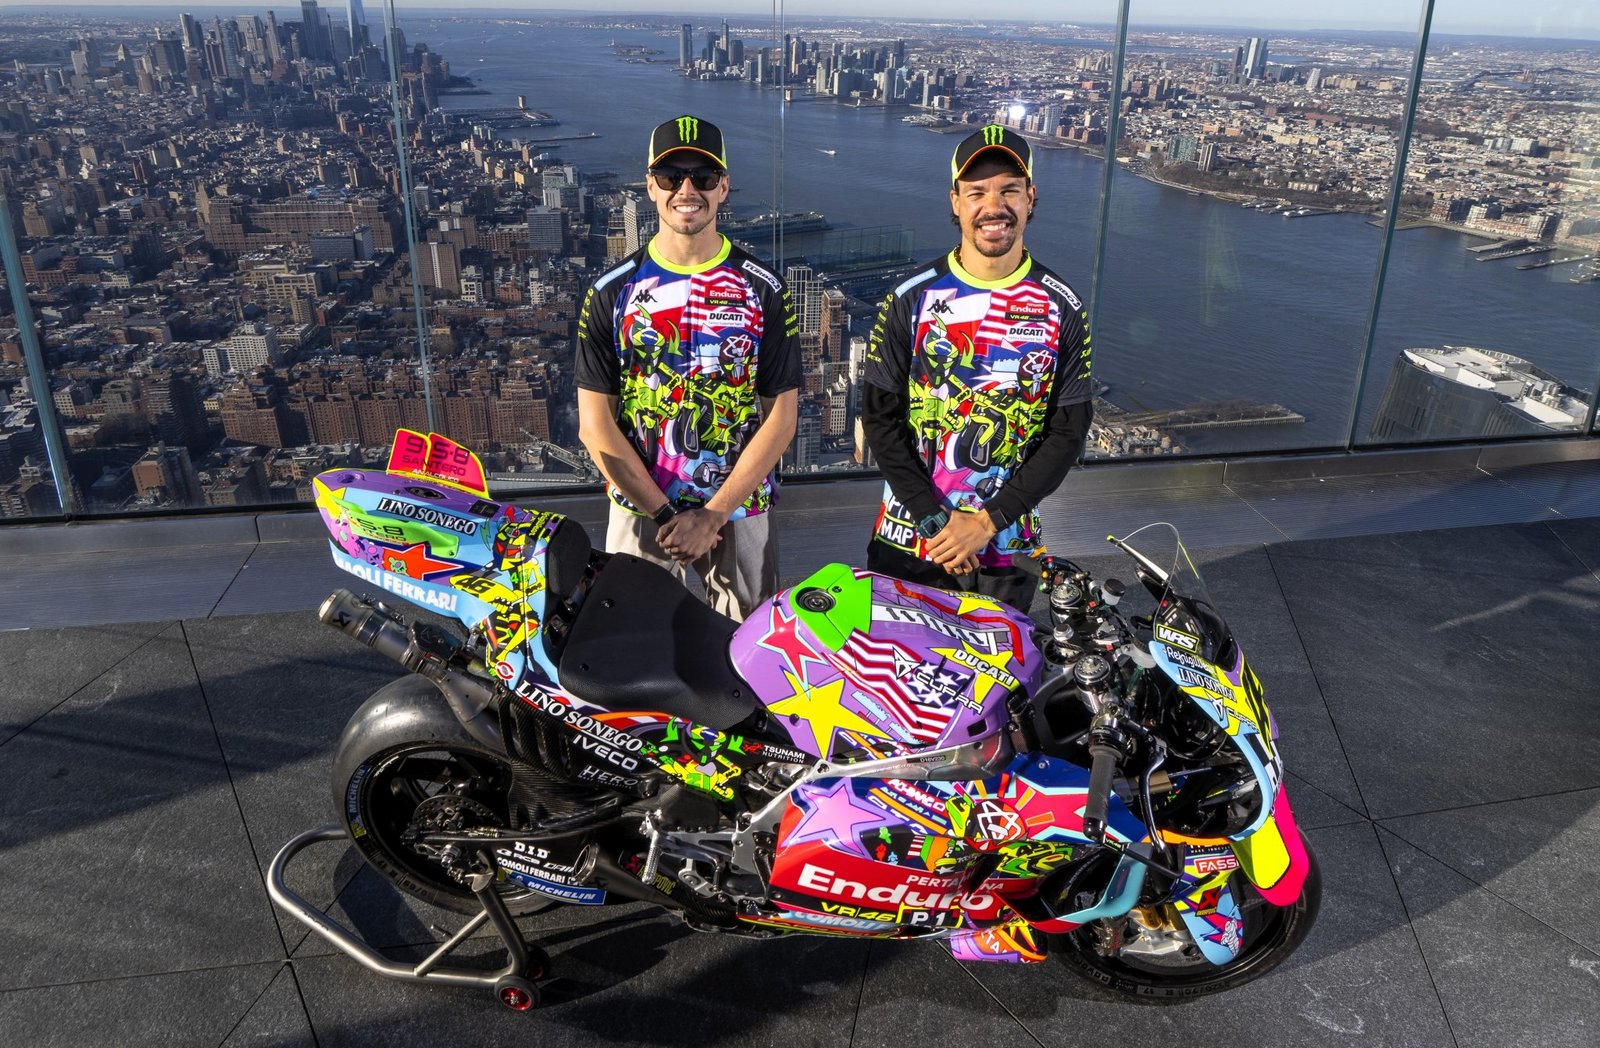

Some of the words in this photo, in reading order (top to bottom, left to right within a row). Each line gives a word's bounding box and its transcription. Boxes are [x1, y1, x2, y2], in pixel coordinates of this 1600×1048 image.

[709, 290, 742, 299] Enduro
[709, 312, 743, 321] DUCATI
[1010, 304, 1044, 314] Enduro
[1009, 328, 1044, 336] DUCATI
[402, 454, 466, 476] SANTERO
[378, 498, 416, 517] LINO
[415, 507, 477, 535] SONEGO
[881, 519, 914, 545] MAP
[383, 571, 458, 612] FERRARI
[1158, 627, 1197, 650] WRS
[953, 648, 1015, 686] DUCATI
[1179, 667, 1205, 687] LINO
[915, 671, 984, 715] CUPRA
[516, 679, 567, 718] LINO
[563, 709, 643, 751] SONEGO
[572, 734, 638, 771] IVECO
[762, 751, 804, 764] NUTRITION
[763, 744, 806, 759] TSUNAMI
[582, 765, 638, 786] HERO
[349, 767, 365, 813] MICHELIN
[497, 857, 529, 873] COMOLI
[530, 867, 566, 884] FERRARI
[527, 880, 596, 900] MICHELIN
[797, 863, 994, 912] Enduro
